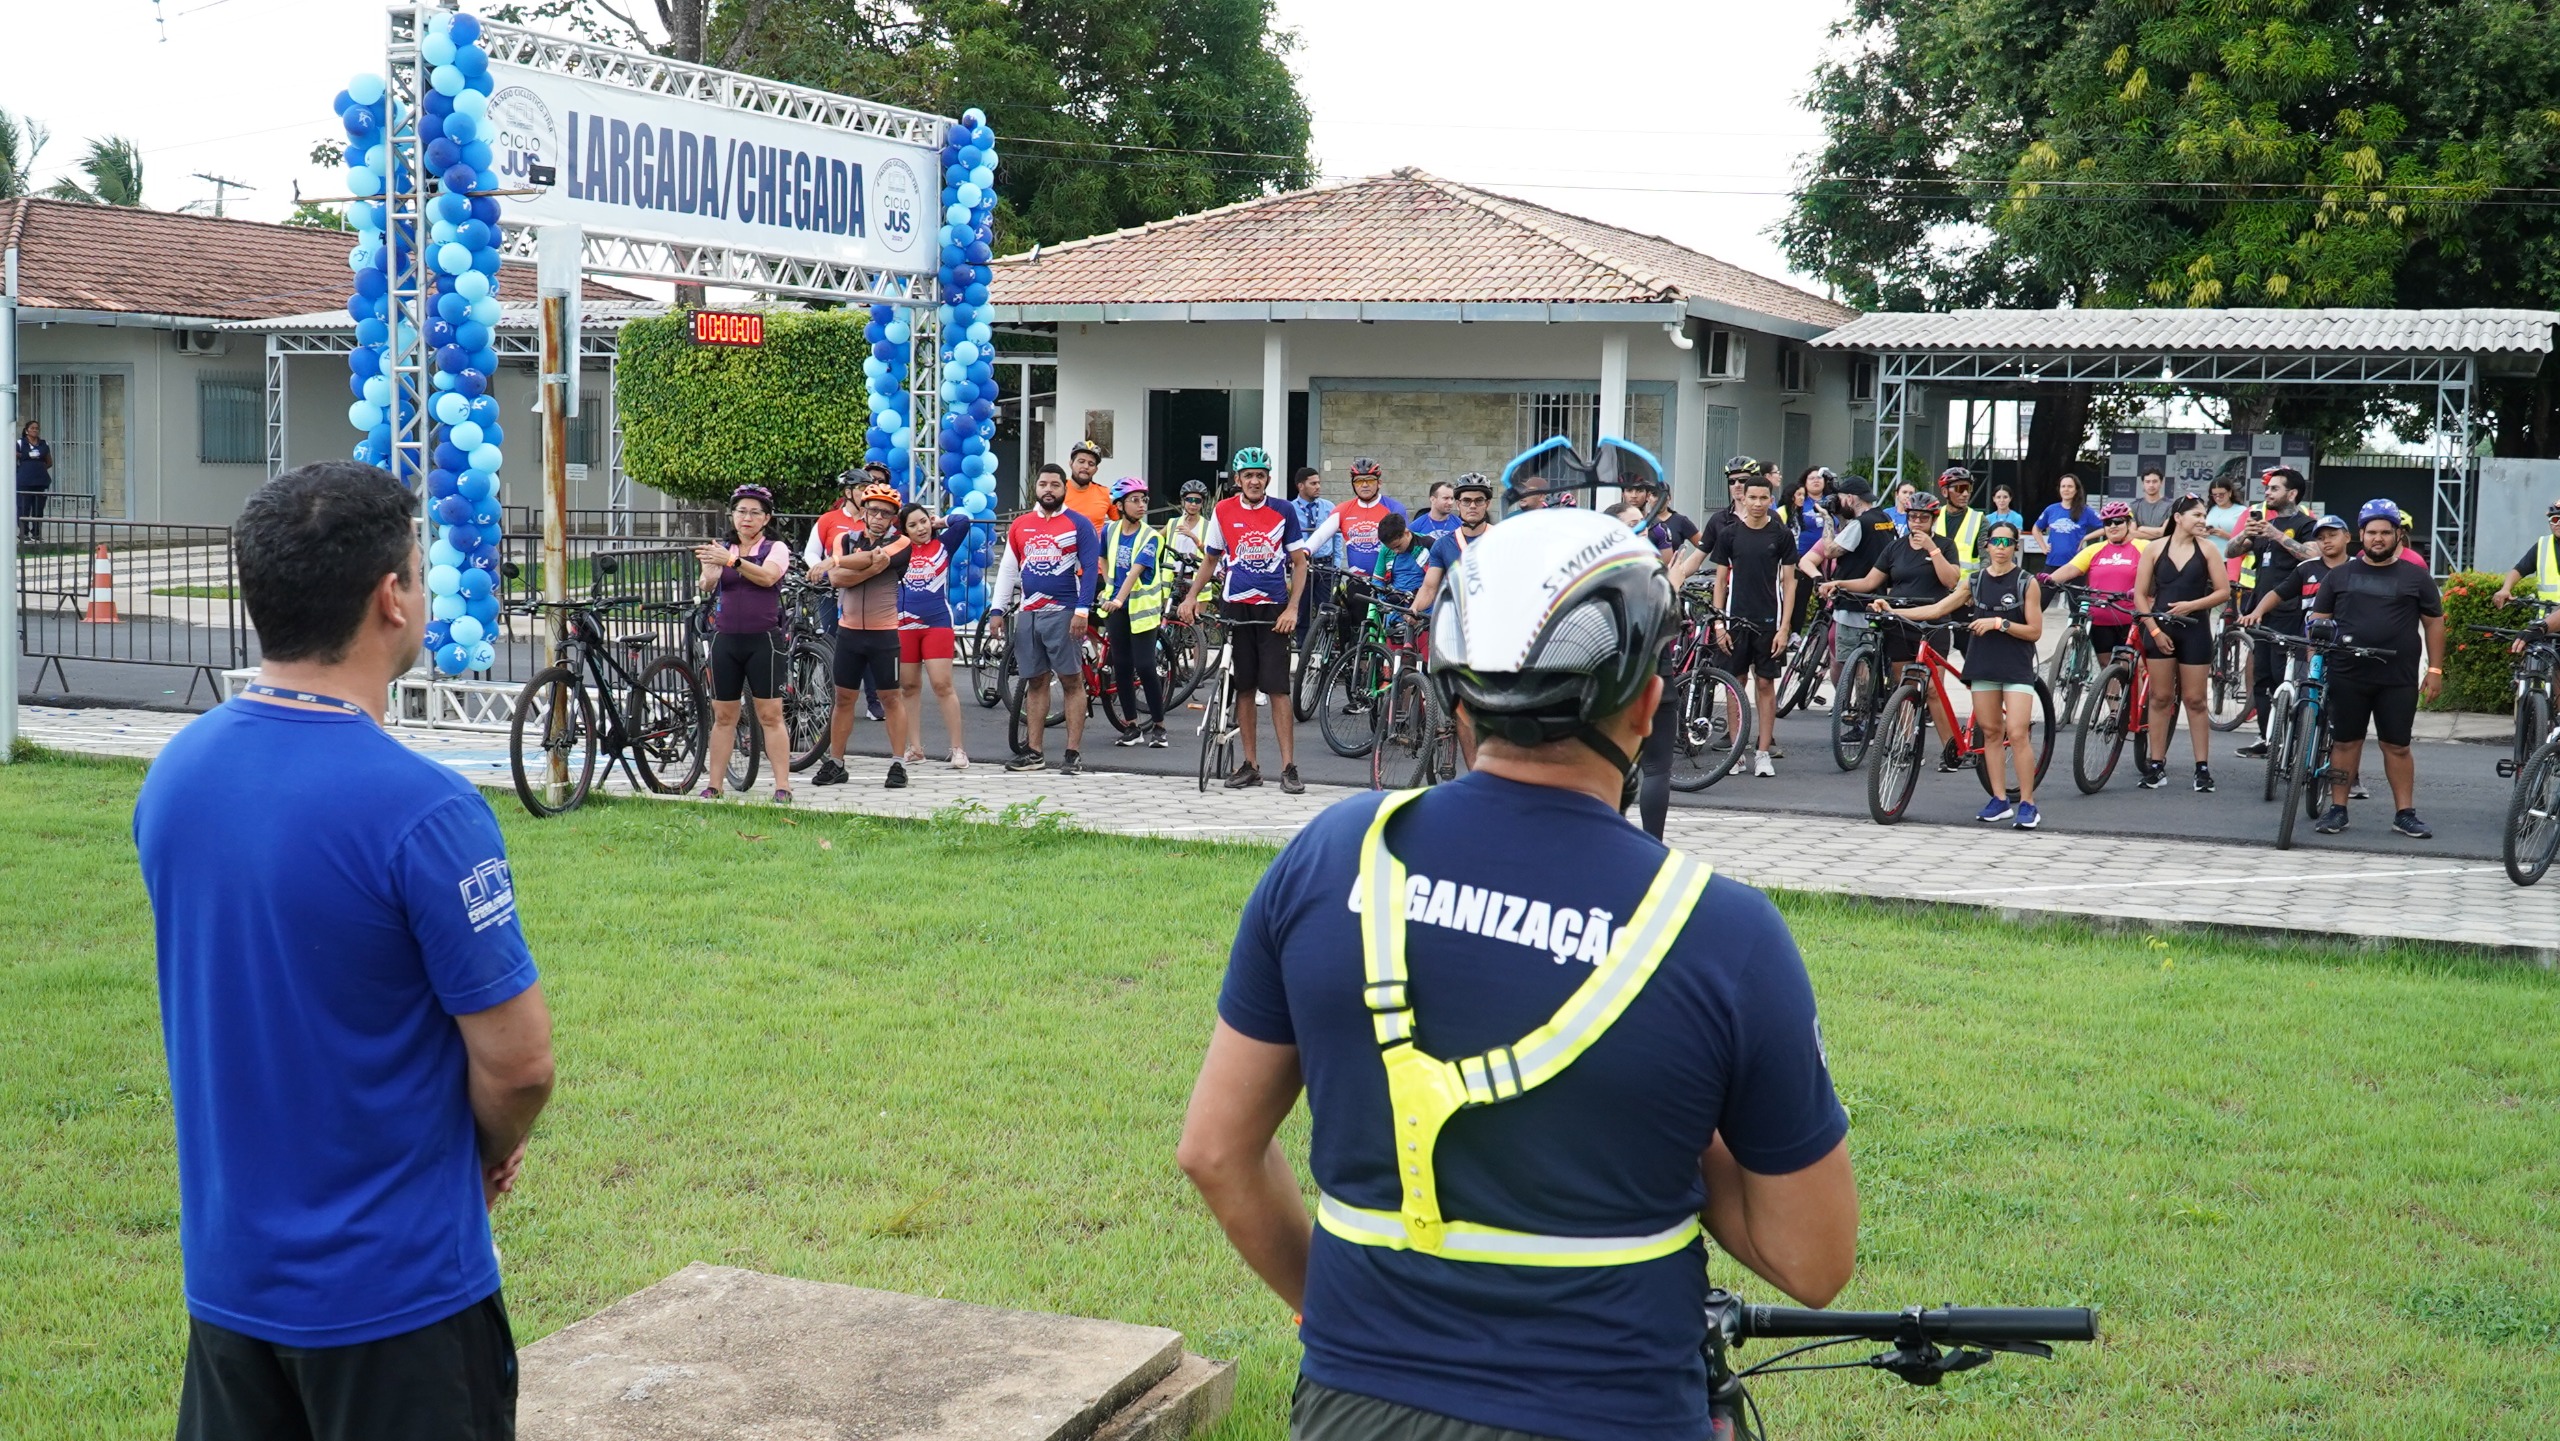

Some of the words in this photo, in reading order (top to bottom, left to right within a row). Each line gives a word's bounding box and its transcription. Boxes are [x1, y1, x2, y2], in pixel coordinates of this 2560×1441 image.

[500, 131, 541, 152] CICLO
[567, 110, 866, 238] LARGADA/CHEGADA
[884, 195, 911, 211] CICLO
[884, 209, 911, 234] JUS
[697, 313, 760, 343] 00:00:00
[2179, 468, 2214, 482] JUS
[2180, 459, 2214, 469] CICLO
[1348, 874, 1628, 966] GANIZAÇÃ
